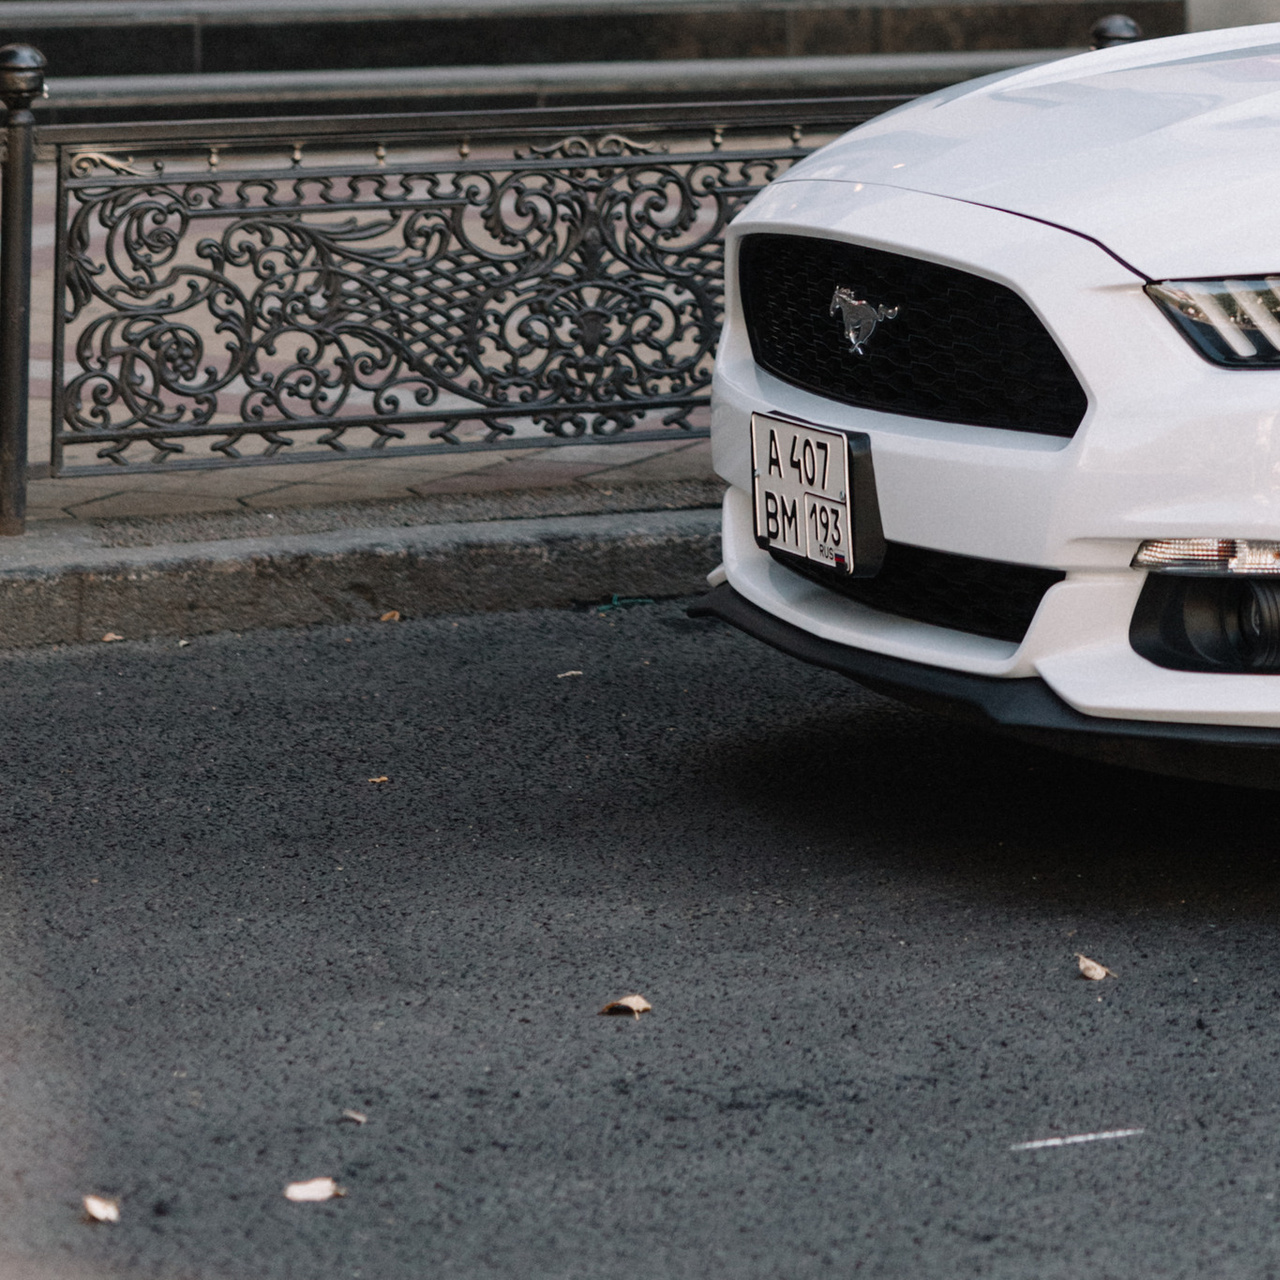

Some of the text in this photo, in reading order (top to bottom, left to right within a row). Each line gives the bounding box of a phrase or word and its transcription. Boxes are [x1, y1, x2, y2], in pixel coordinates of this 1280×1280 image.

[768, 428, 830, 490] A 407
[765, 490, 842, 547] BM 193
[819, 543, 835, 561] RUS
